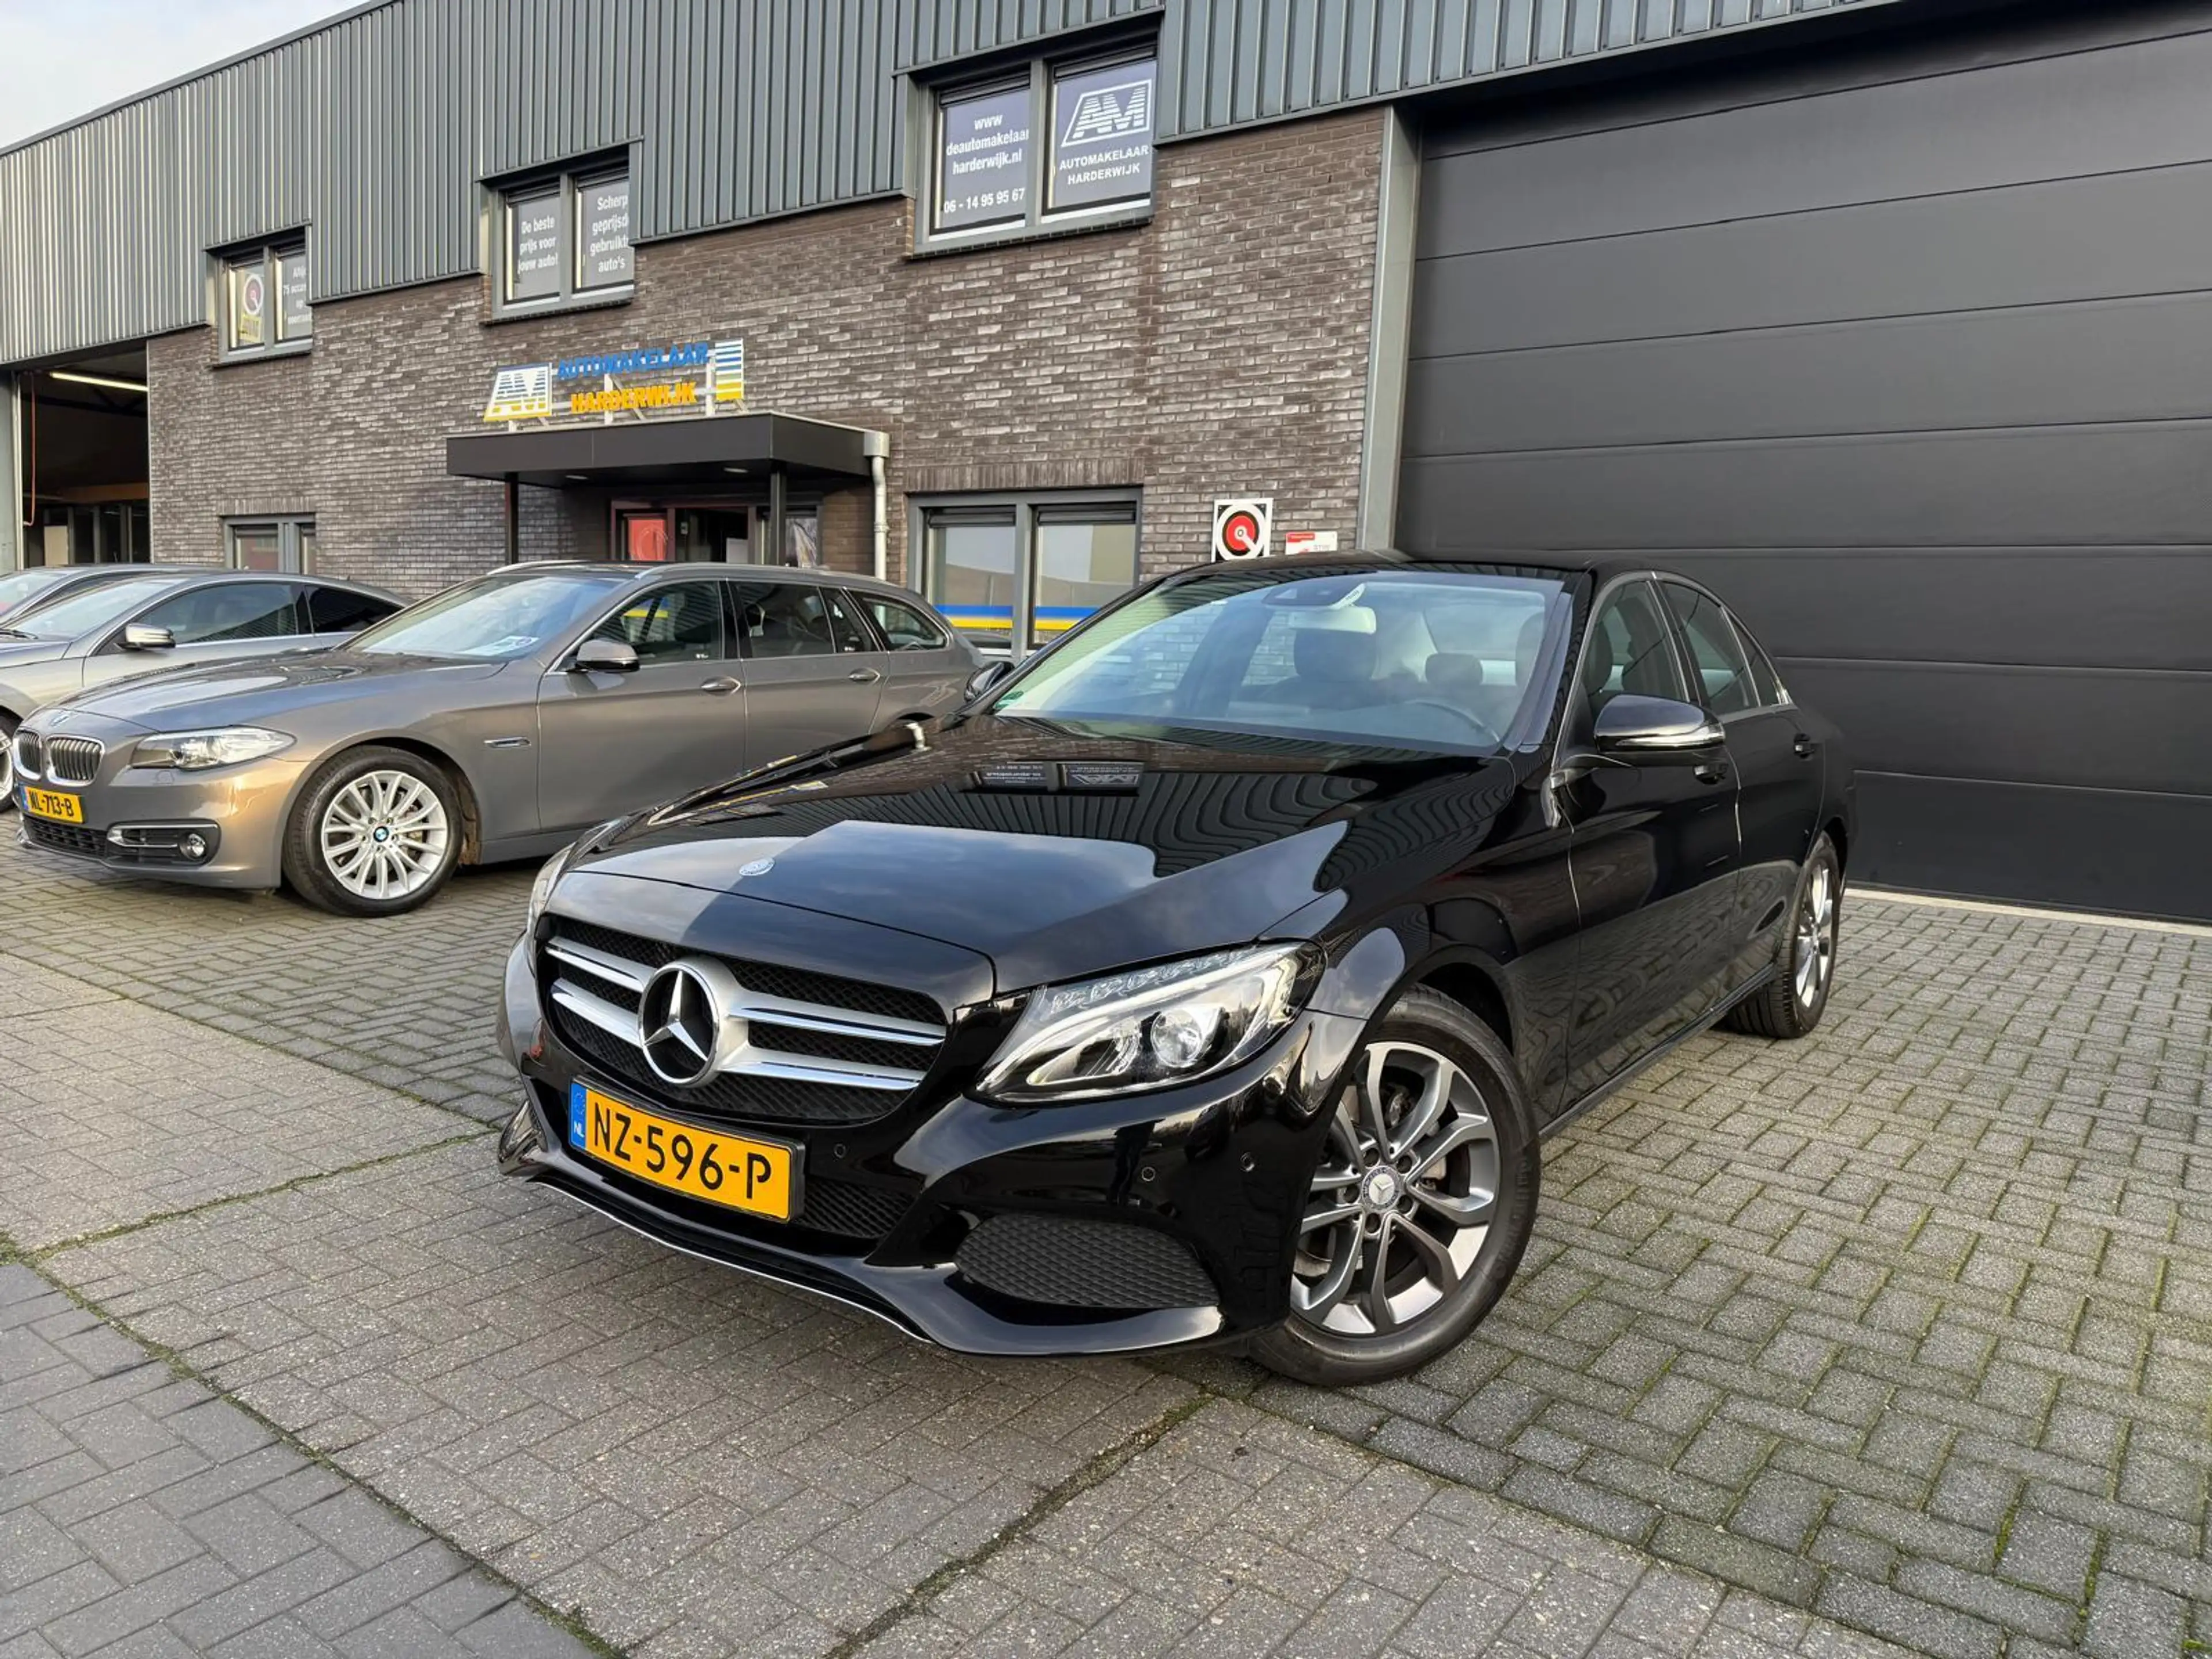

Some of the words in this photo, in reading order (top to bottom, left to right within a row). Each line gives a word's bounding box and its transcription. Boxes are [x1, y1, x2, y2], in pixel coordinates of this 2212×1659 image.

[974, 114, 1002, 130] www
[952, 148, 1022, 175] harderwijk.nl
[1059, 145, 1150, 171] AUTOMAKELAAR
[1067, 163, 1141, 185] HARDERWIJK
[597, 194, 628, 211] Scherp
[944, 200, 956, 214] 06
[967, 195, 978, 210] 14
[982, 192, 994, 207] 95
[997, 190, 1010, 204] 95
[1012, 187, 1025, 202] 67
[533, 215, 555, 232] beste
[520, 238, 537, 255] prijs
[539, 237, 556, 249] voor
[598, 255, 626, 272] auto's
[558, 342, 709, 380] AUTOMAKELAAR
[570, 381, 698, 414] HARDERWIJK
[573, 1119, 585, 1138] NL
[593, 1101, 772, 1199] NZ-596-P
